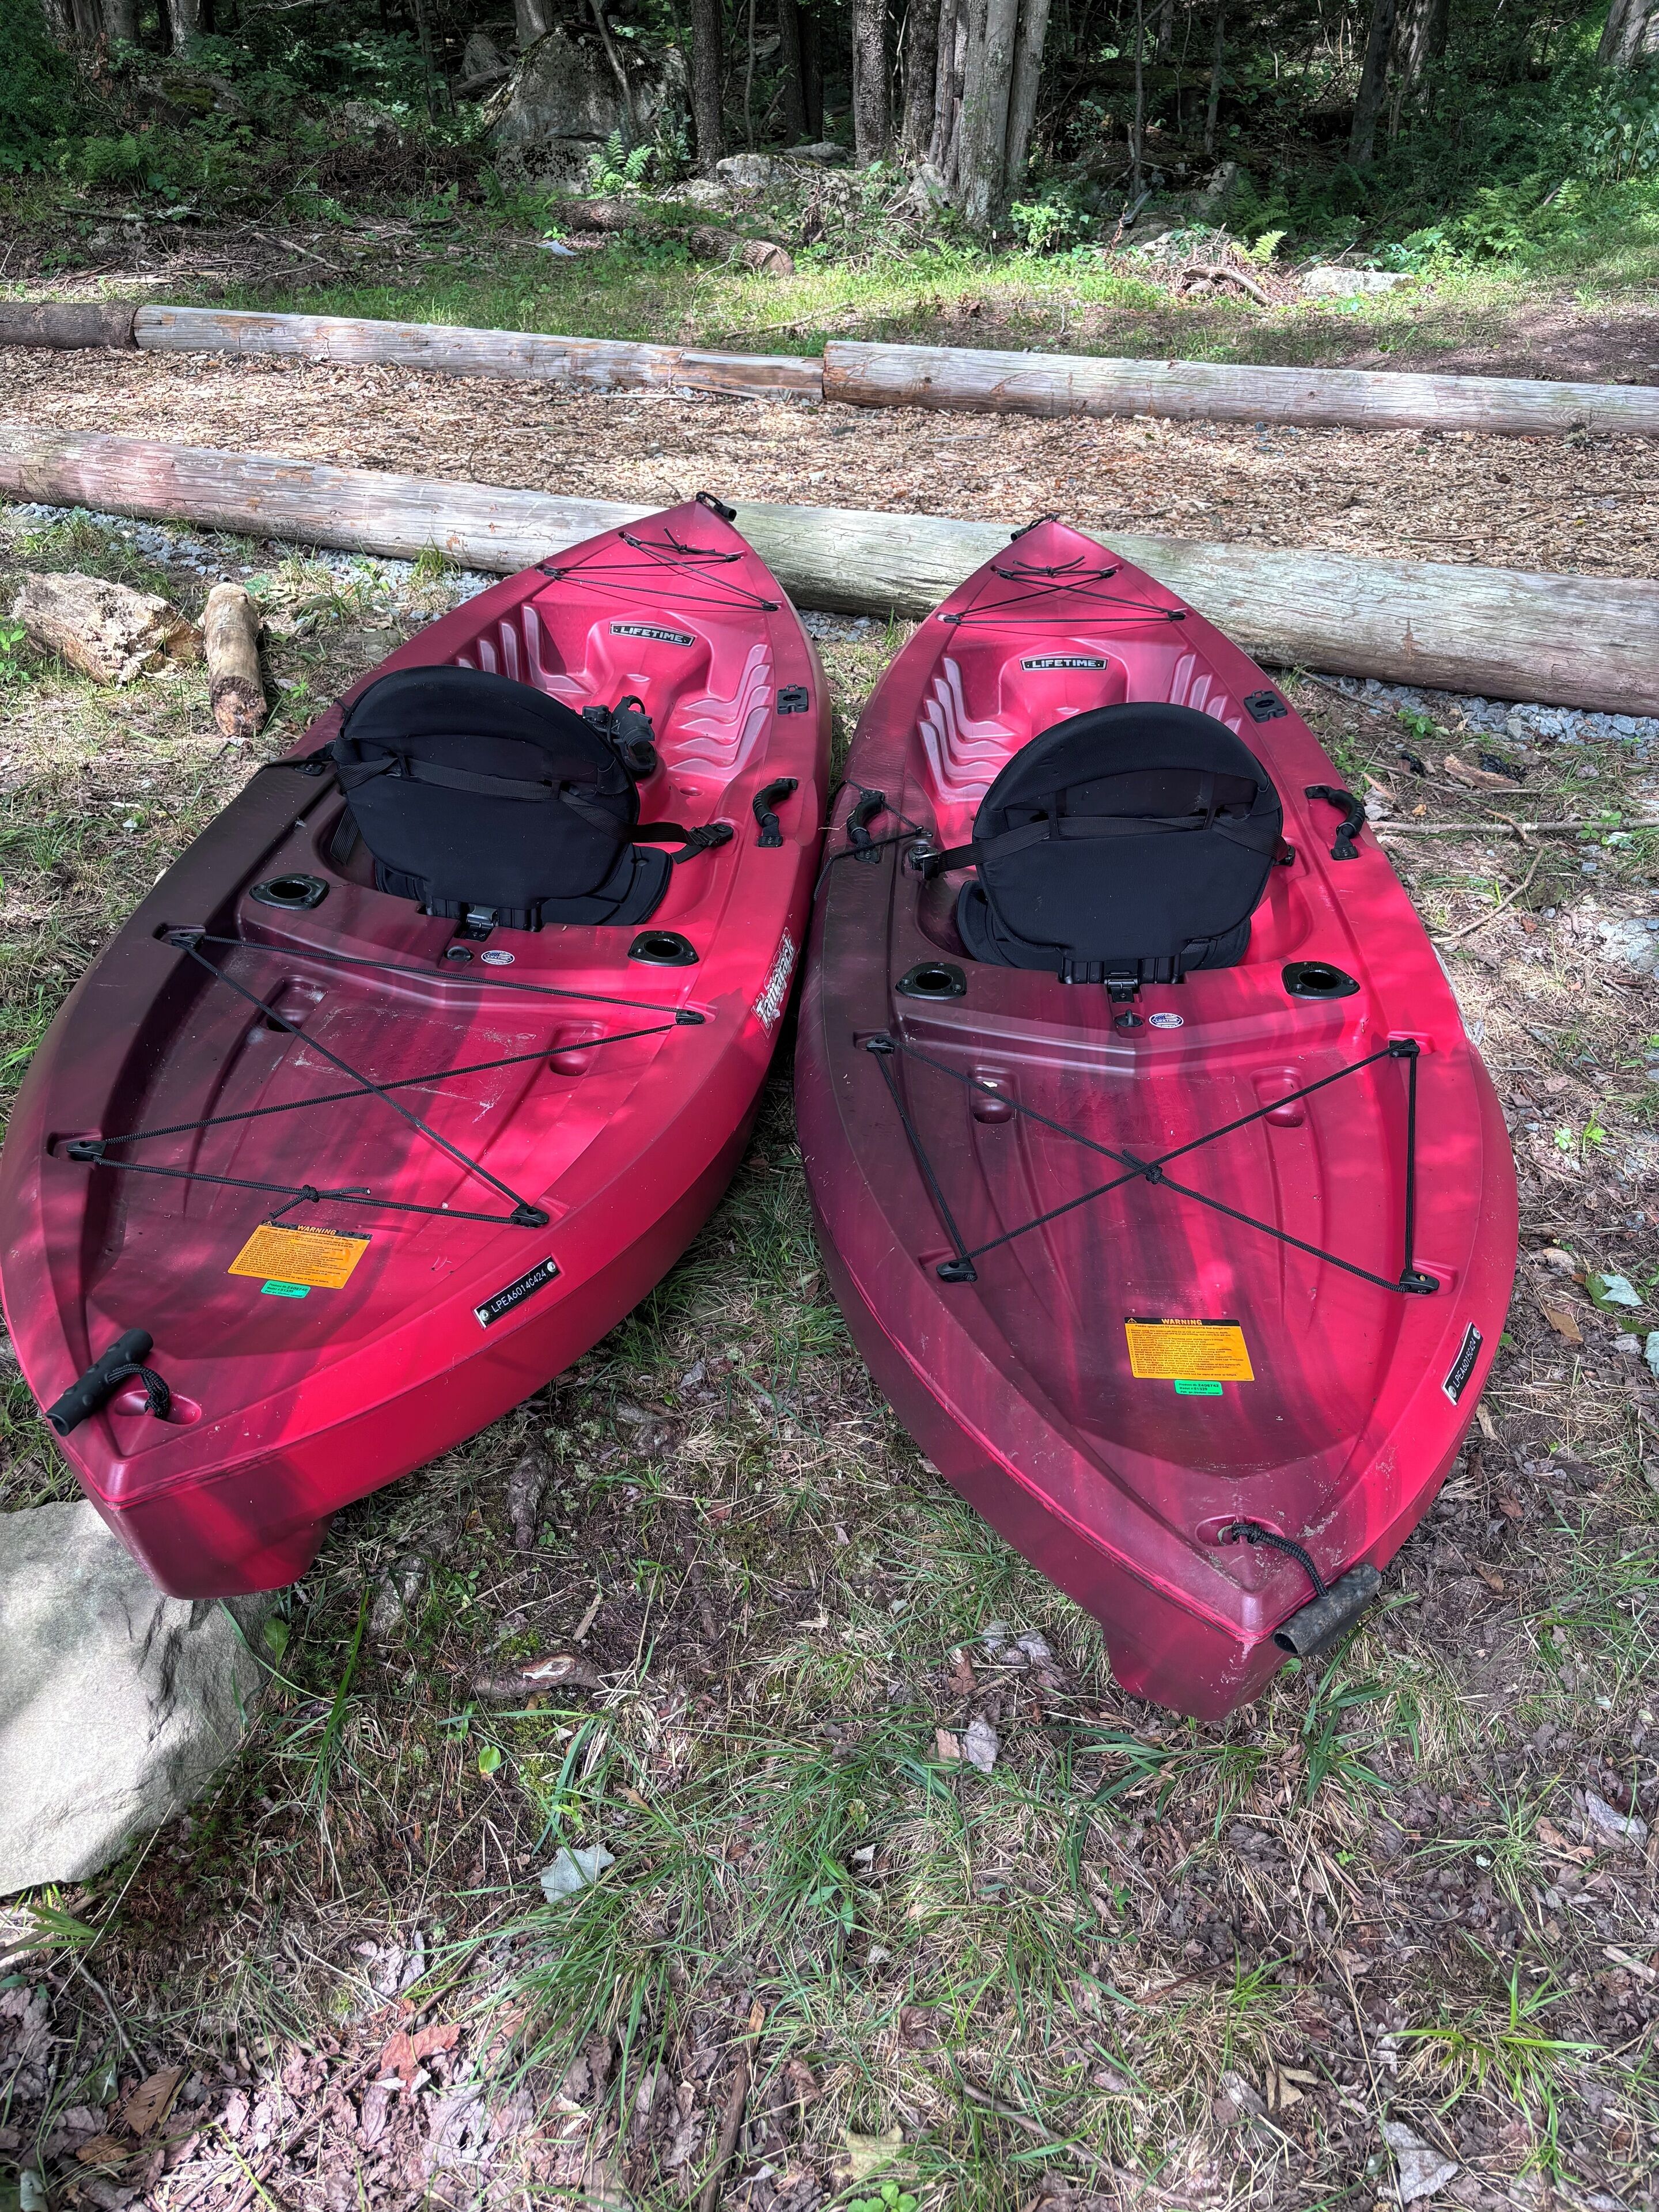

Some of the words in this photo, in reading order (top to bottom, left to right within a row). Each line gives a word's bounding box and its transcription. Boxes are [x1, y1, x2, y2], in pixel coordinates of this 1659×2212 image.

[620, 626, 683, 642] LIFETIME
[1032, 659, 1096, 668] LIFETIME
[756, 934, 794, 1029] Tamarack
[297, 1225, 336, 1236] WARNING
[491, 1268, 547, 1313] LPEA6014C424
[1452, 1336, 1476, 1388] LPEA6015C424
